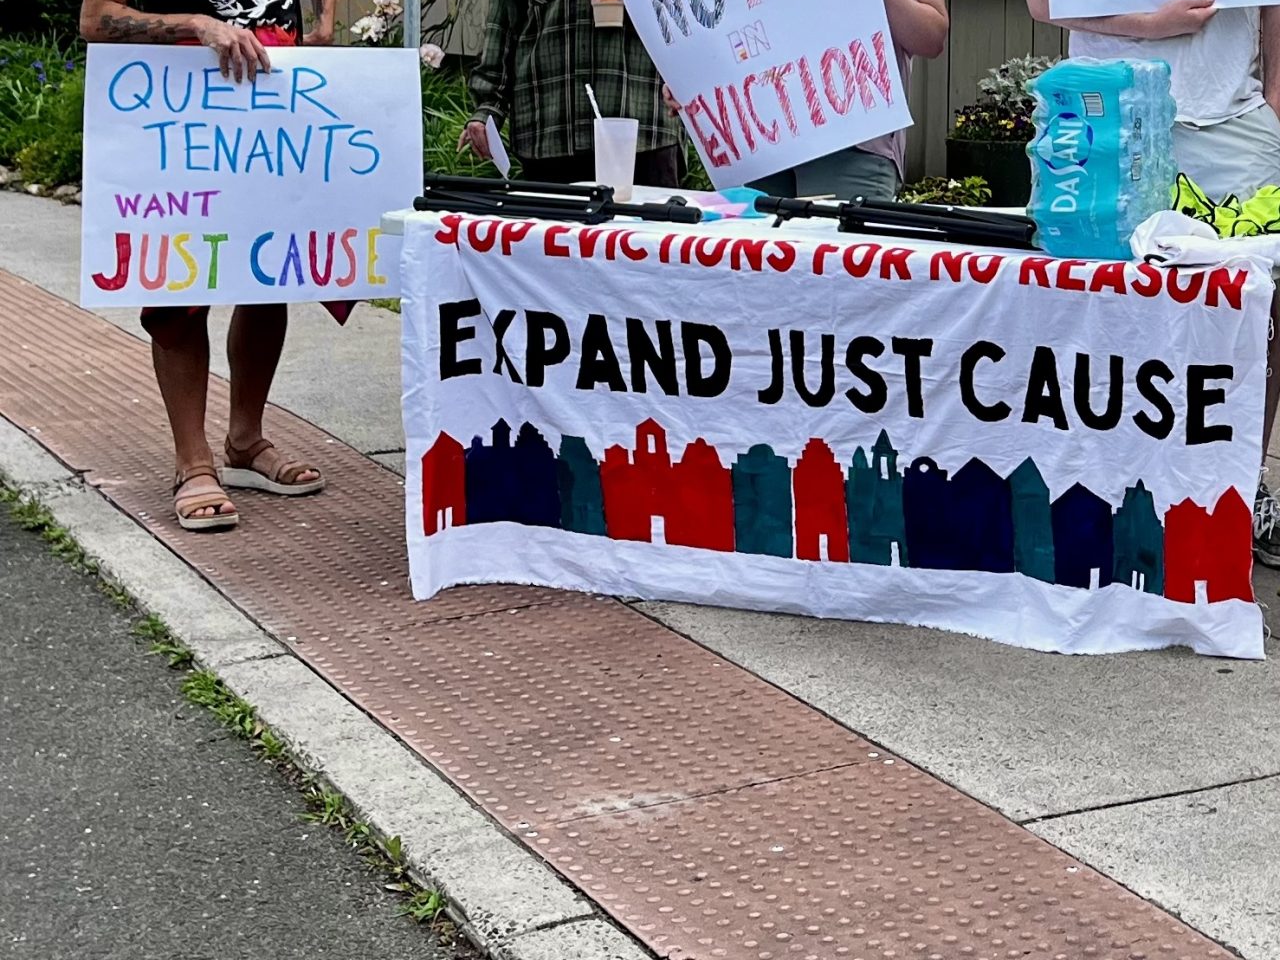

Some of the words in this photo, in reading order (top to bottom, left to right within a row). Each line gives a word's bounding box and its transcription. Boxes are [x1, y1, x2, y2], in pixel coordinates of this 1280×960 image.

[727, 19, 771, 64] IN
[108, 60, 340, 120] QUEER
[683, 30, 893, 169] EVICTION
[143, 120, 381, 182] TENANTS
[1051, 121, 1088, 212] DASANI
[115, 190, 220, 218] WANT
[91, 231, 228, 291] JUST
[249, 230, 387, 290] CAUSE
[434, 215, 536, 256] SOP
[812, 243, 914, 280] FOR
[930, 251, 1006, 284] NO
[1018, 257, 1249, 310] REASON
[439, 298, 732, 398] EXPAND
[757, 328, 933, 418] JUST
[959, 339, 1234, 445] CAUSE
